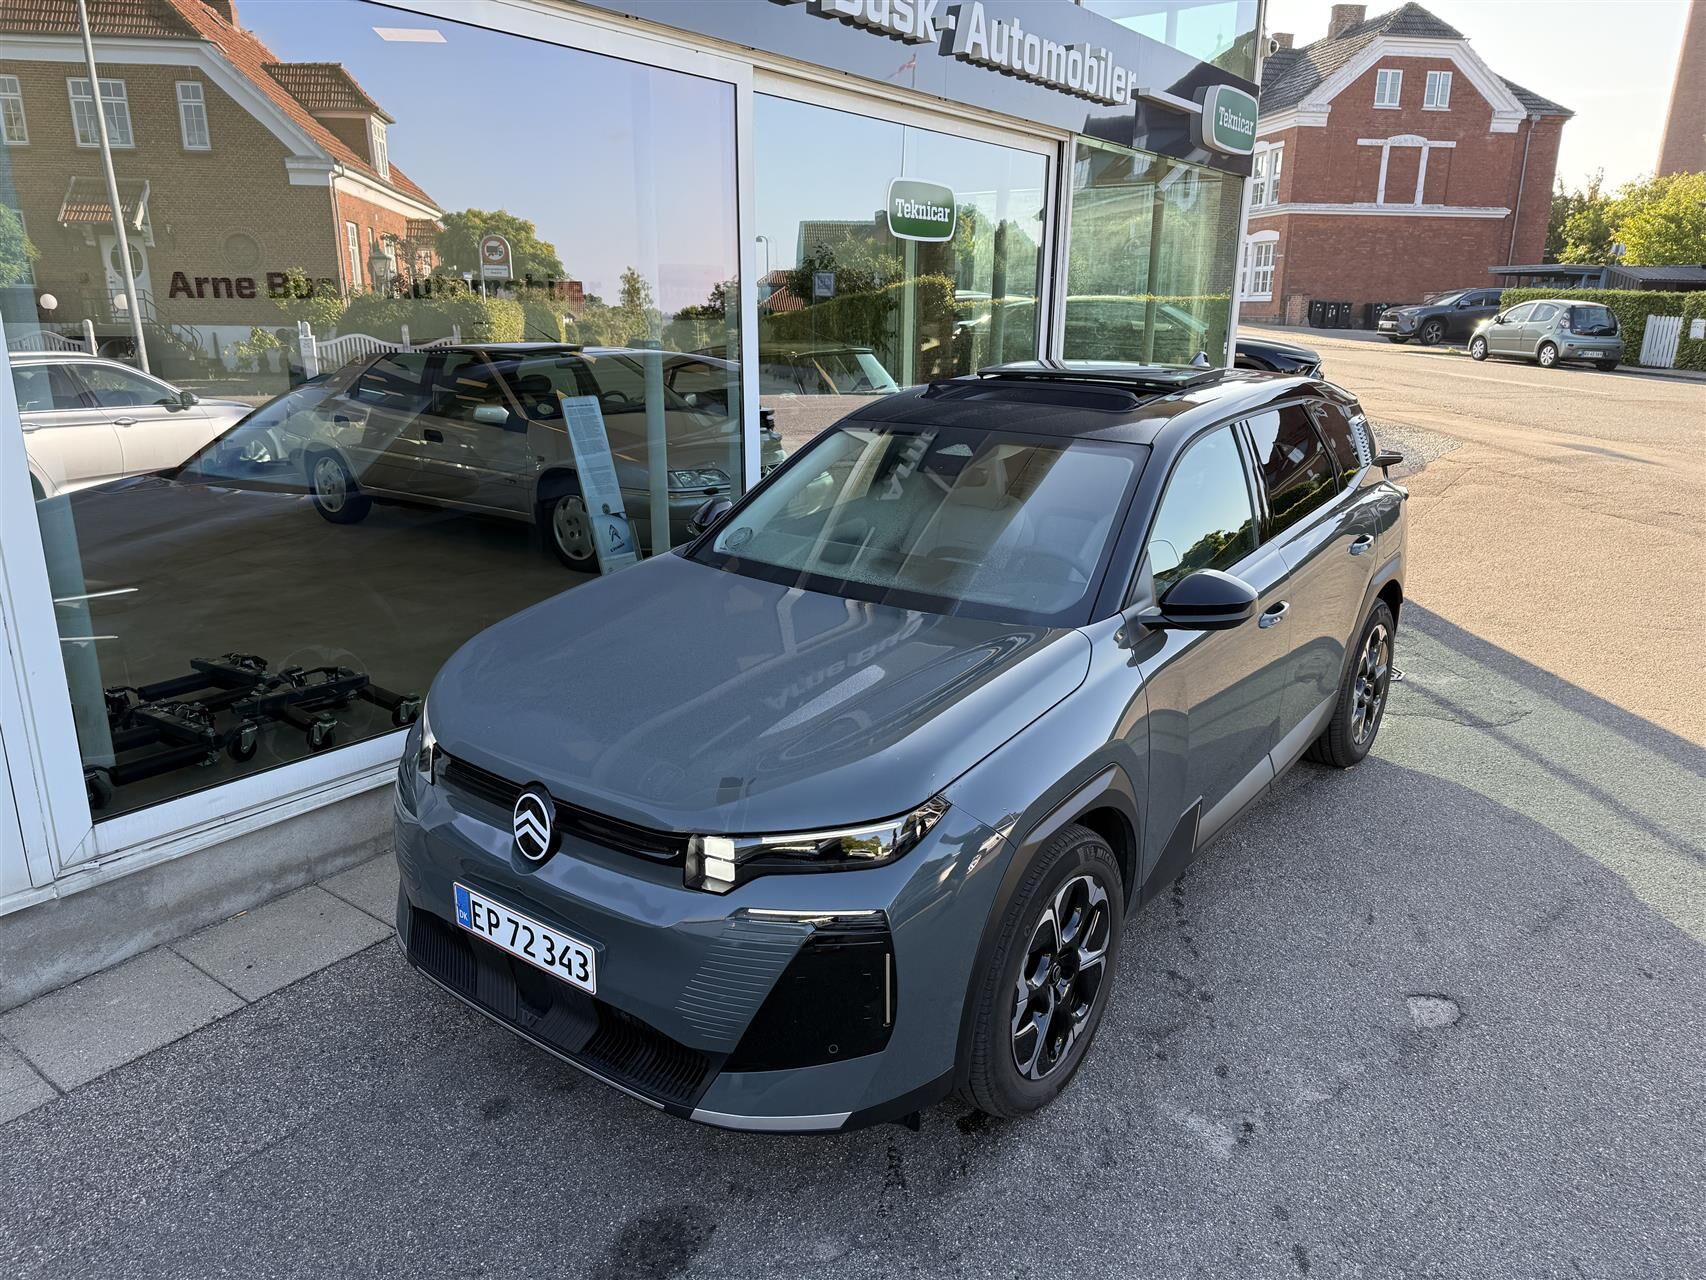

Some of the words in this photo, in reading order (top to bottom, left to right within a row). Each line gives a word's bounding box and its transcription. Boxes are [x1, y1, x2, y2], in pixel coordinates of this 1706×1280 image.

[834, 0, 938, 43] usk
[964, 1, 1136, 105] Automobiler
[1219, 106, 1254, 136] Teknicar
[895, 198, 951, 222] Teknicar
[169, 271, 257, 299] Arne
[266, 272, 342, 300] Bus
[459, 909, 469, 921] DK
[471, 899, 500, 937] EP
[507, 917, 537, 958] 72
[543, 934, 590, 982] 343
